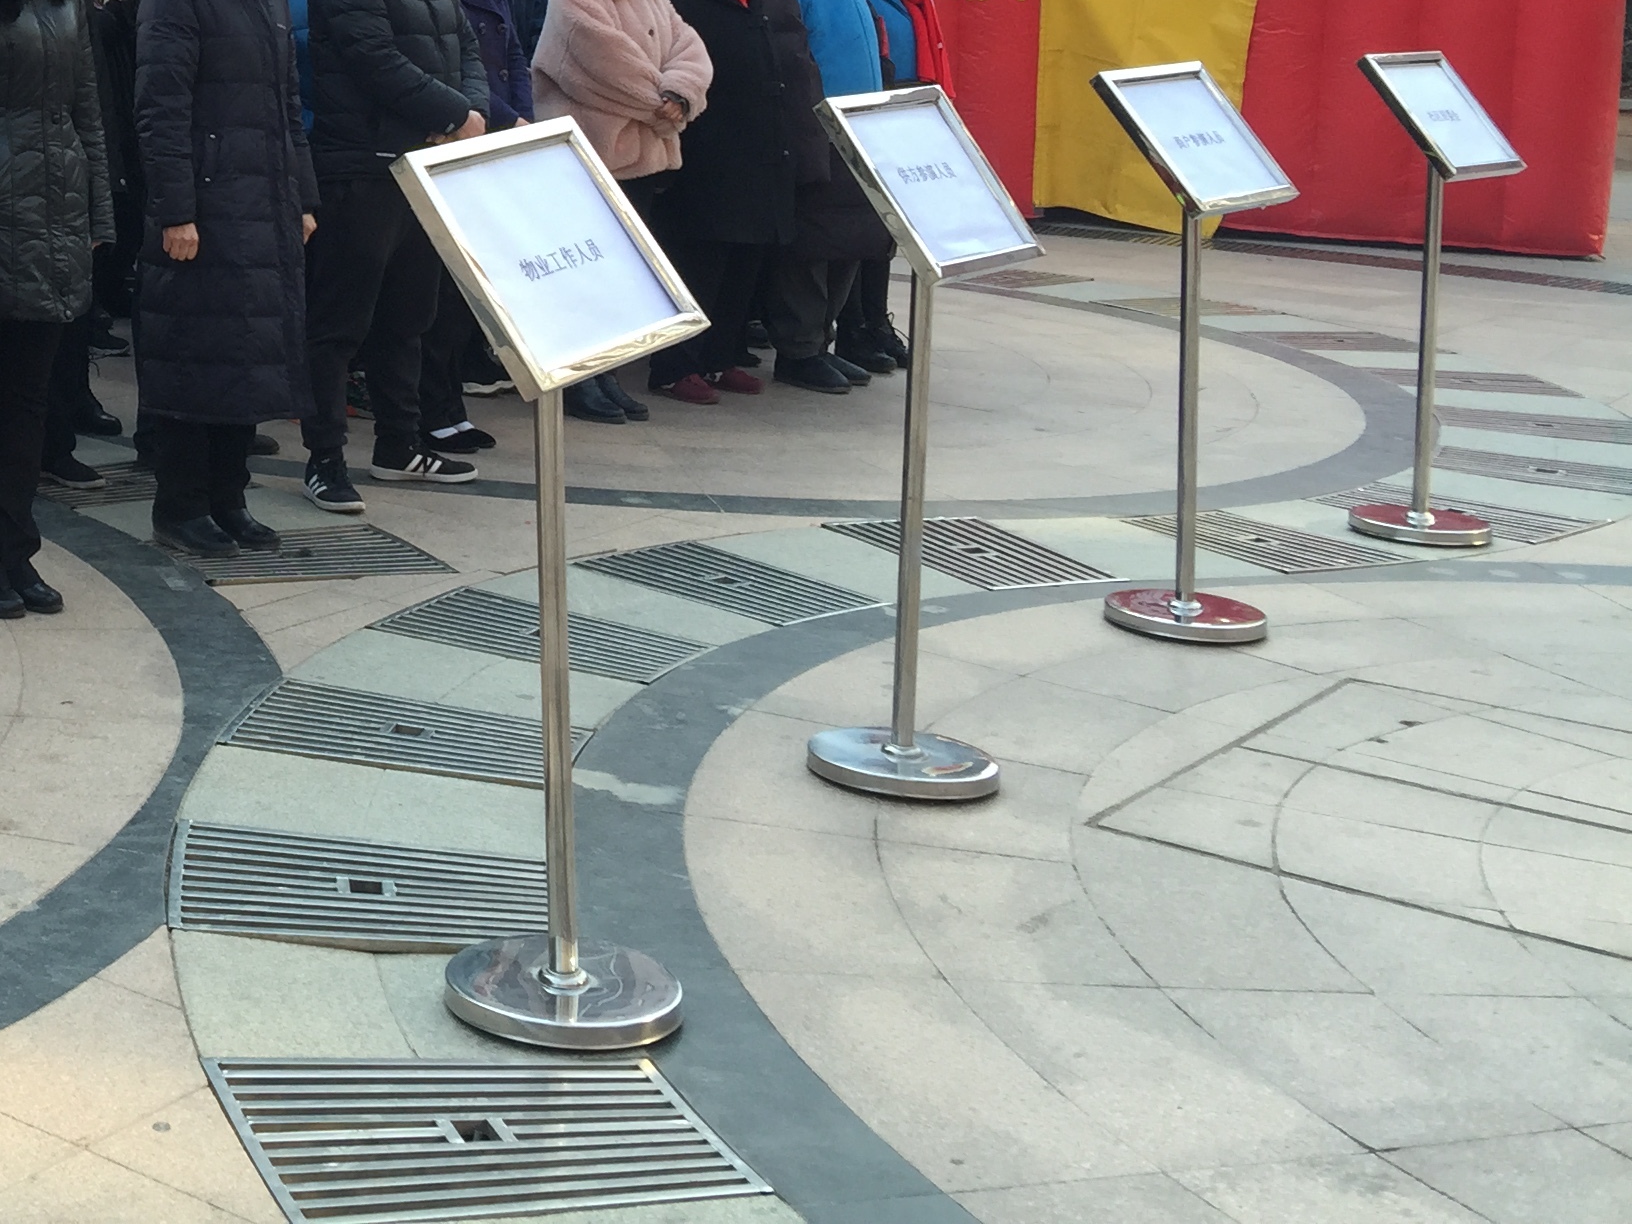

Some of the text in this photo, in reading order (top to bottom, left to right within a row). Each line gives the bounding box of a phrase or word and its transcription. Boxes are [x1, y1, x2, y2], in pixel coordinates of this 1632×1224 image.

[518, 238, 604, 282] 物业工作人员
